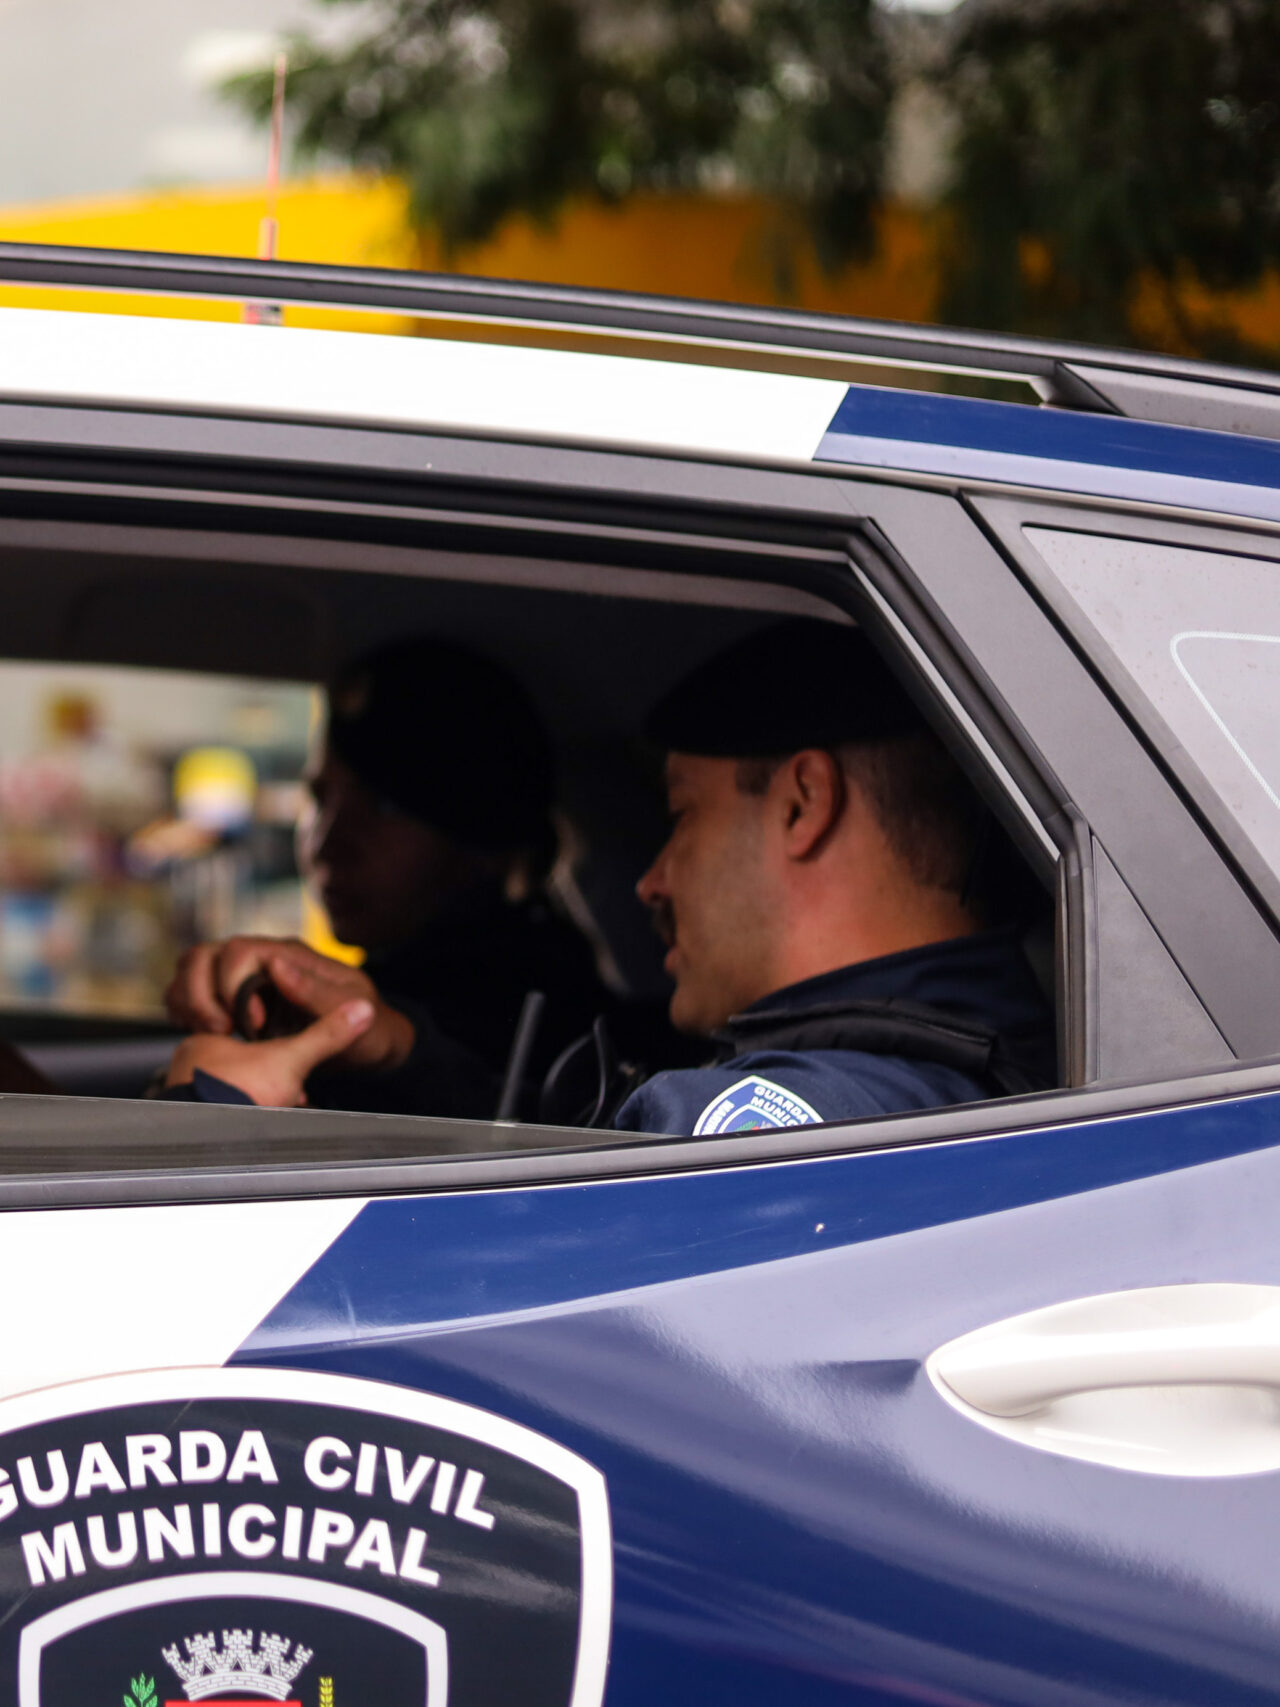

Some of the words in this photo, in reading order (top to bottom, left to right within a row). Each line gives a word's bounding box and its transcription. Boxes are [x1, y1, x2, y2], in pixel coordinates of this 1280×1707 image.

[753, 1085, 809, 1125] GUARDA
[303, 1436, 496, 1530] CIVIL
[20, 1502, 441, 1588] MUNICIPAL
